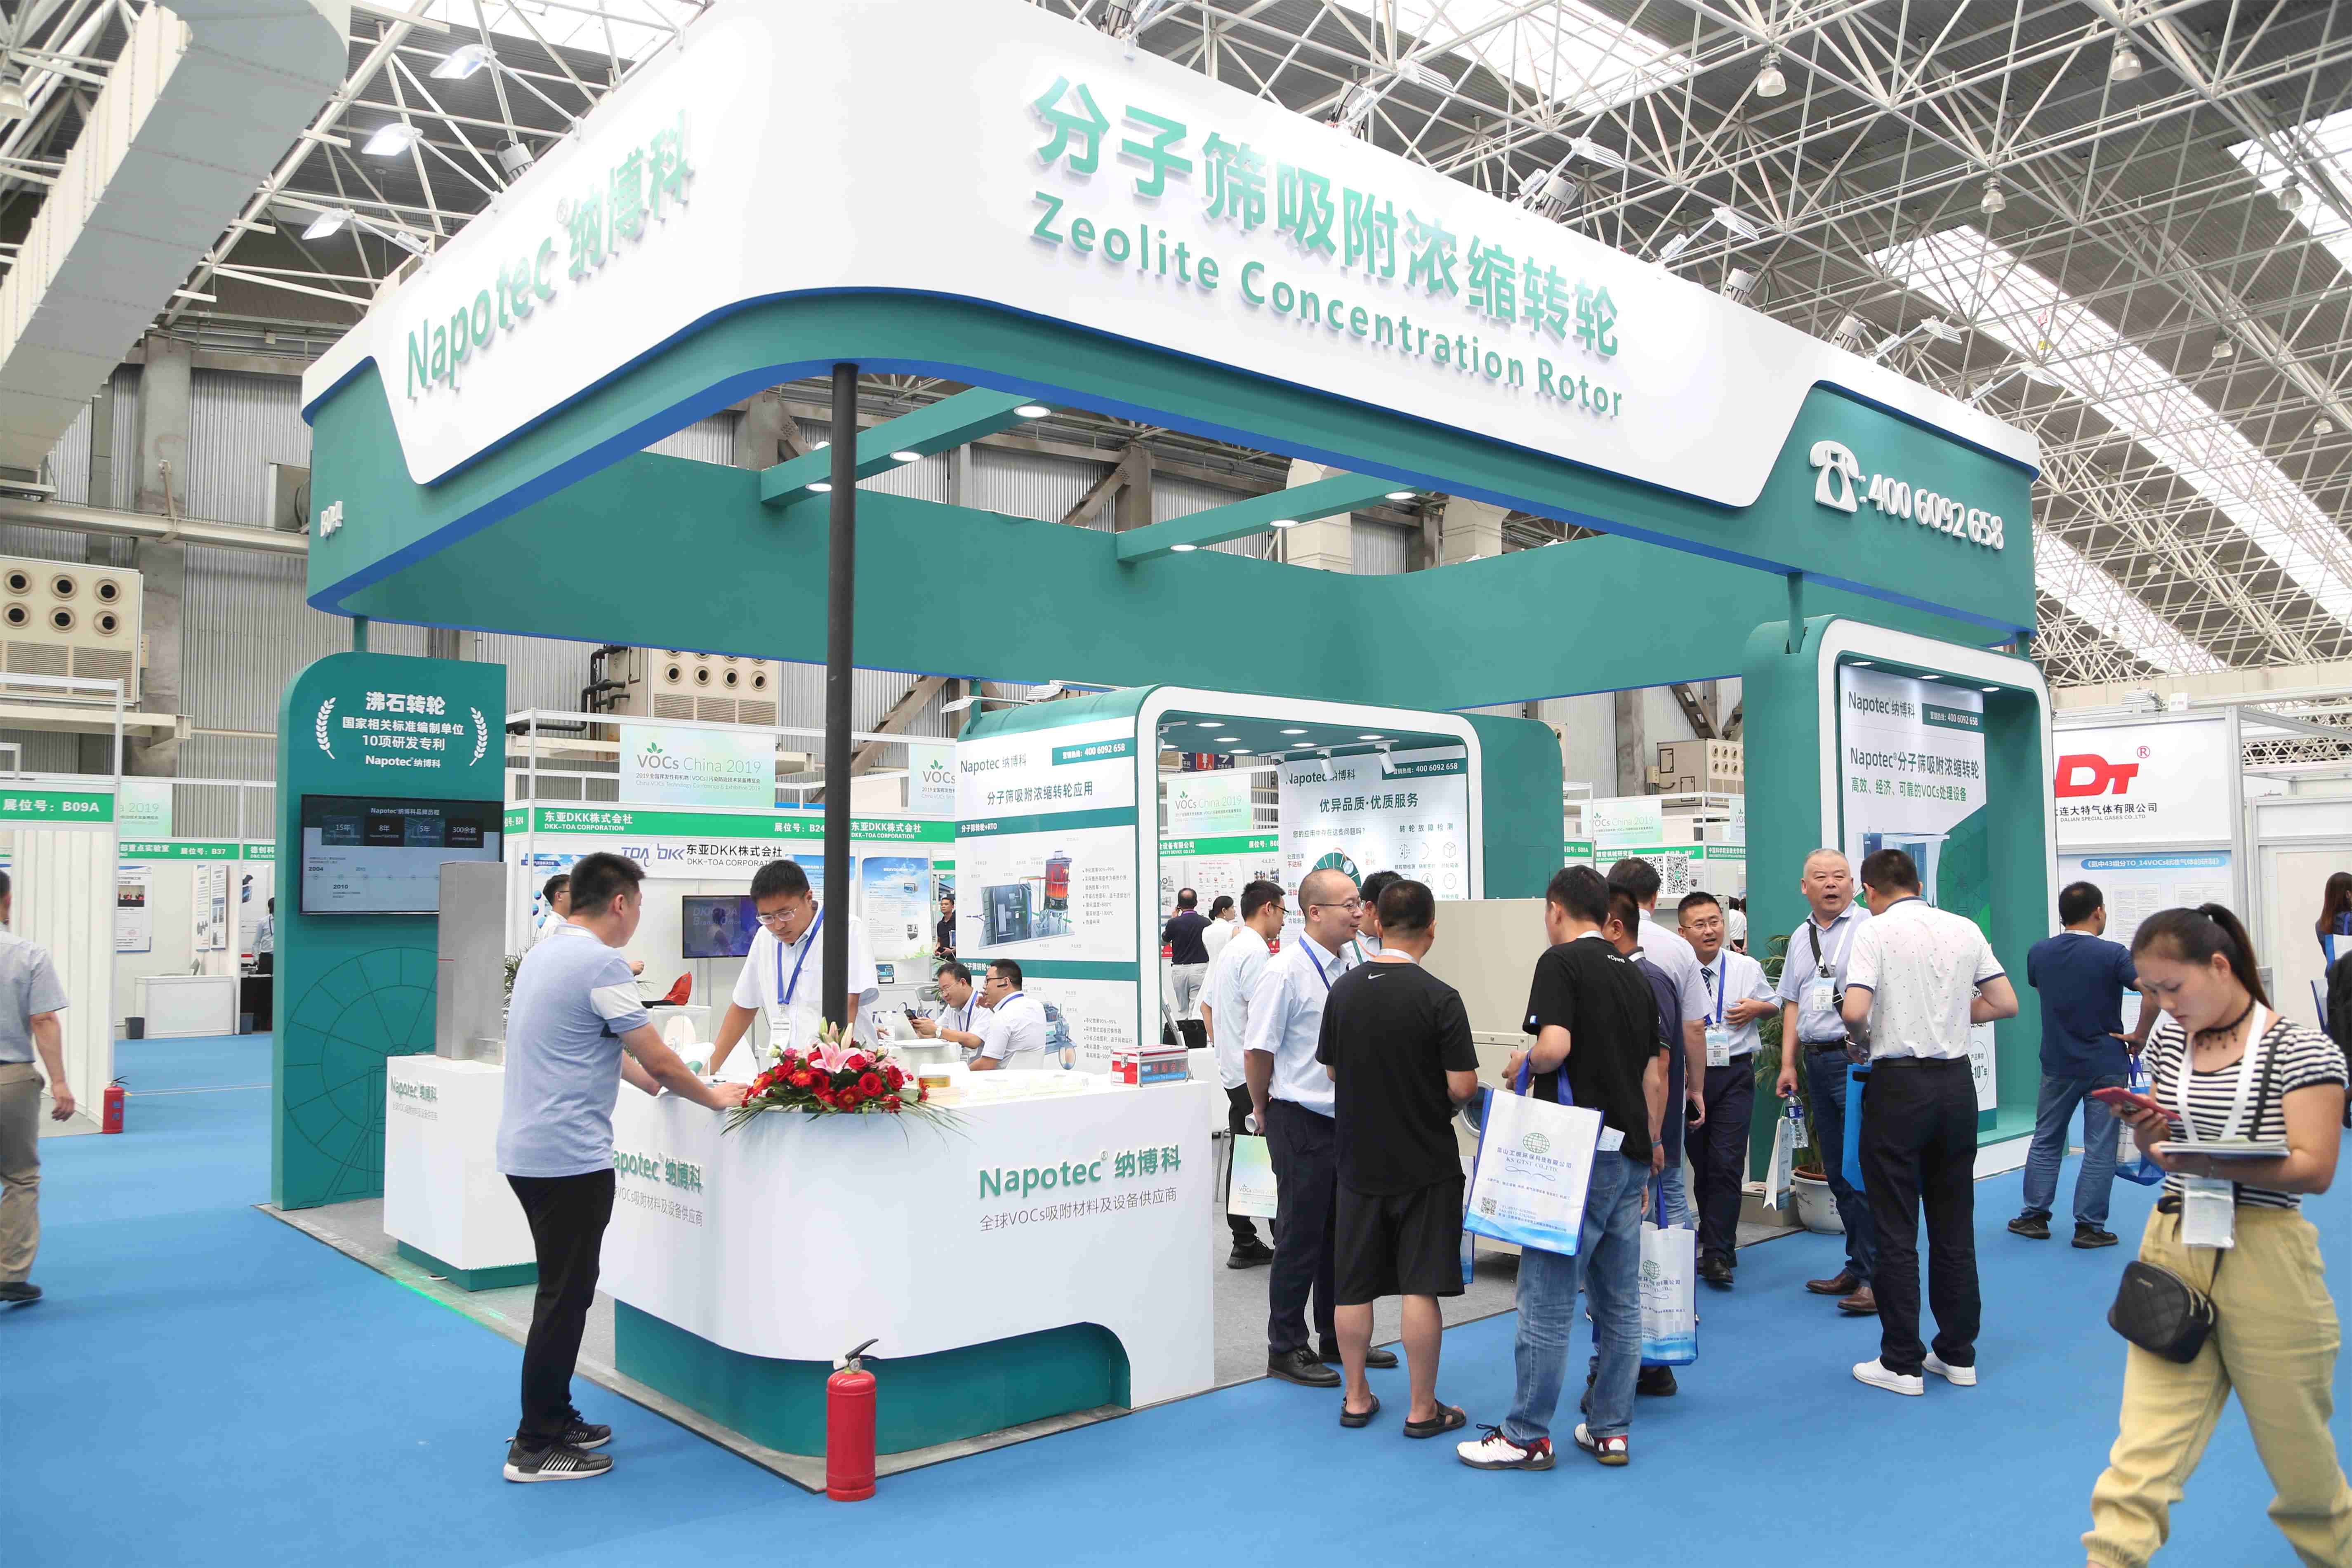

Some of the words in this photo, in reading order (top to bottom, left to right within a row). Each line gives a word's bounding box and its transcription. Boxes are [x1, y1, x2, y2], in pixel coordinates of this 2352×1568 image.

[568, 108, 694, 281] 纳博科
[1030, 74, 1619, 357] 分子筛吸附浓缩转轮
[1030, 190, 1220, 290] Zeolite
[1240, 261, 1525, 388] Concentration
[1537, 357, 1623, 417] Rotor
[1914, 489, 1966, 538] 6092
[1968, 508, 2004, 550] 658
[366, 691, 445, 715] 沸石转轮
[1891, 700, 1915, 719] 纳博科
[342, 717, 464, 735] 国家相关标准编制单位
[1957, 714, 1969, 724] 6092
[1969, 717, 1978, 726] 658
[362, 735, 445, 751] 10项研发专利
[1097, 744, 1112, 755] 6092
[1113, 743, 1125, 752] 658
[414, 758, 441, 768] 纳博科
[637, 754, 679, 769] VOCs
[683, 757, 721, 772] China
[726, 759, 761, 774] 2019
[960, 759, 999, 776] Napotec
[1002, 753, 1027, 768] 纳博科
[1429, 763, 1445, 771] 6092
[923, 771, 955, 784] VOCs
[987, 781, 1093, 805] 分子筛吸附浓缩转轮应用
[1851, 776, 1966, 802] 高效、经济、可靠的VOCs处理设备
[129, 802, 159, 813] 2019
[1175, 799, 1197, 809] VOCs
[1198, 798, 1219, 808] China
[1222, 795, 1242, 806] 2019
[1320, 792, 1419, 813] 优异品质·优质服务
[2055, 803, 2157, 816] 连大特气体有限公司
[544, 811, 633, 824] 东亚DKK株式会社
[1612, 818, 1632, 826] China
[1633, 816, 1654, 825] 2019
[851, 821, 921, 833] 东亚DKK株式会社
[686, 844, 782, 857] 东亚DKK株式会社
[1114, 1144, 1182, 1178] 纳博科
[665, 1158, 703, 1194] 纳博科
[979, 1186, 1178, 1232] 全球VOCs吸附材料及设备供应商
